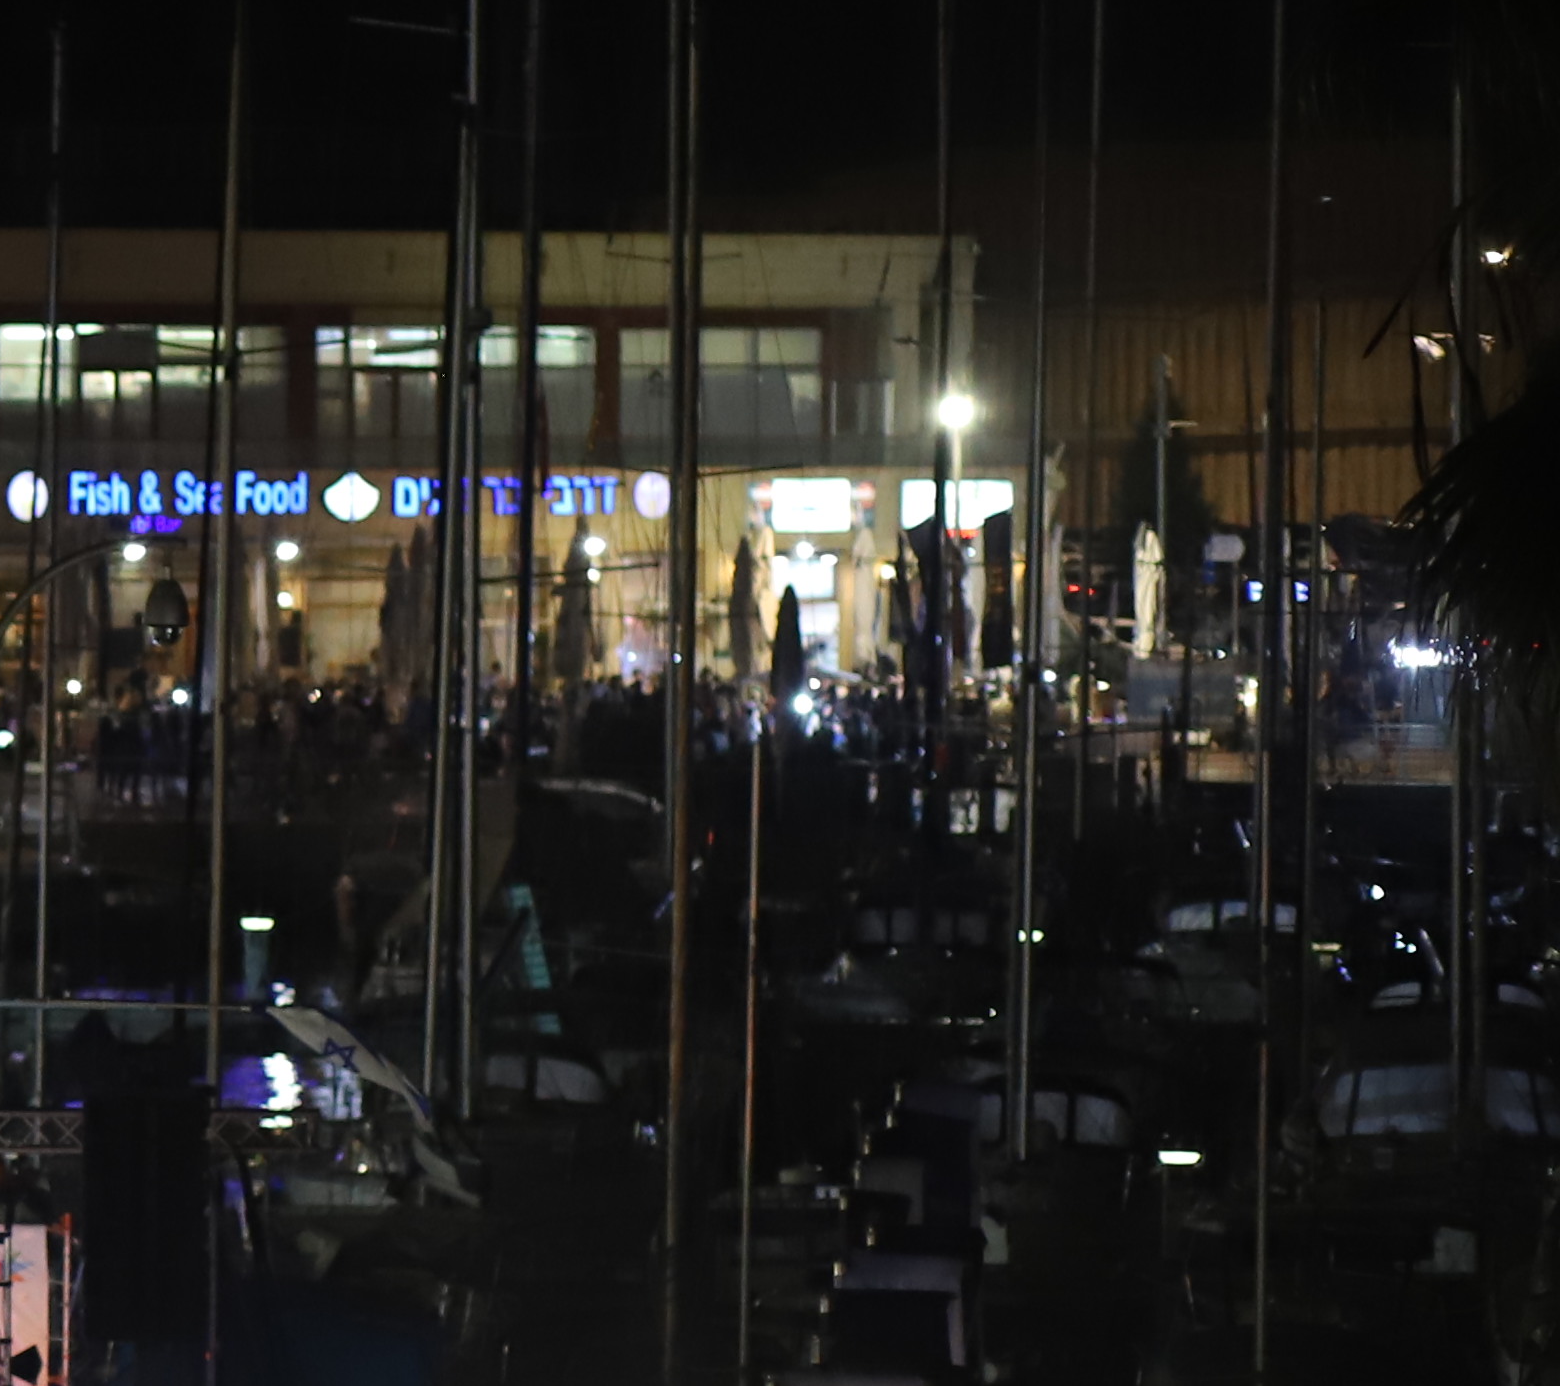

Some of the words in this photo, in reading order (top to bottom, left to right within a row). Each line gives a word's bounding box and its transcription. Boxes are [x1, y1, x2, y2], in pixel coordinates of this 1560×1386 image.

[70, 471, 131, 515] Fish
[139, 470, 163, 515] &
[236, 471, 306, 515] Food
